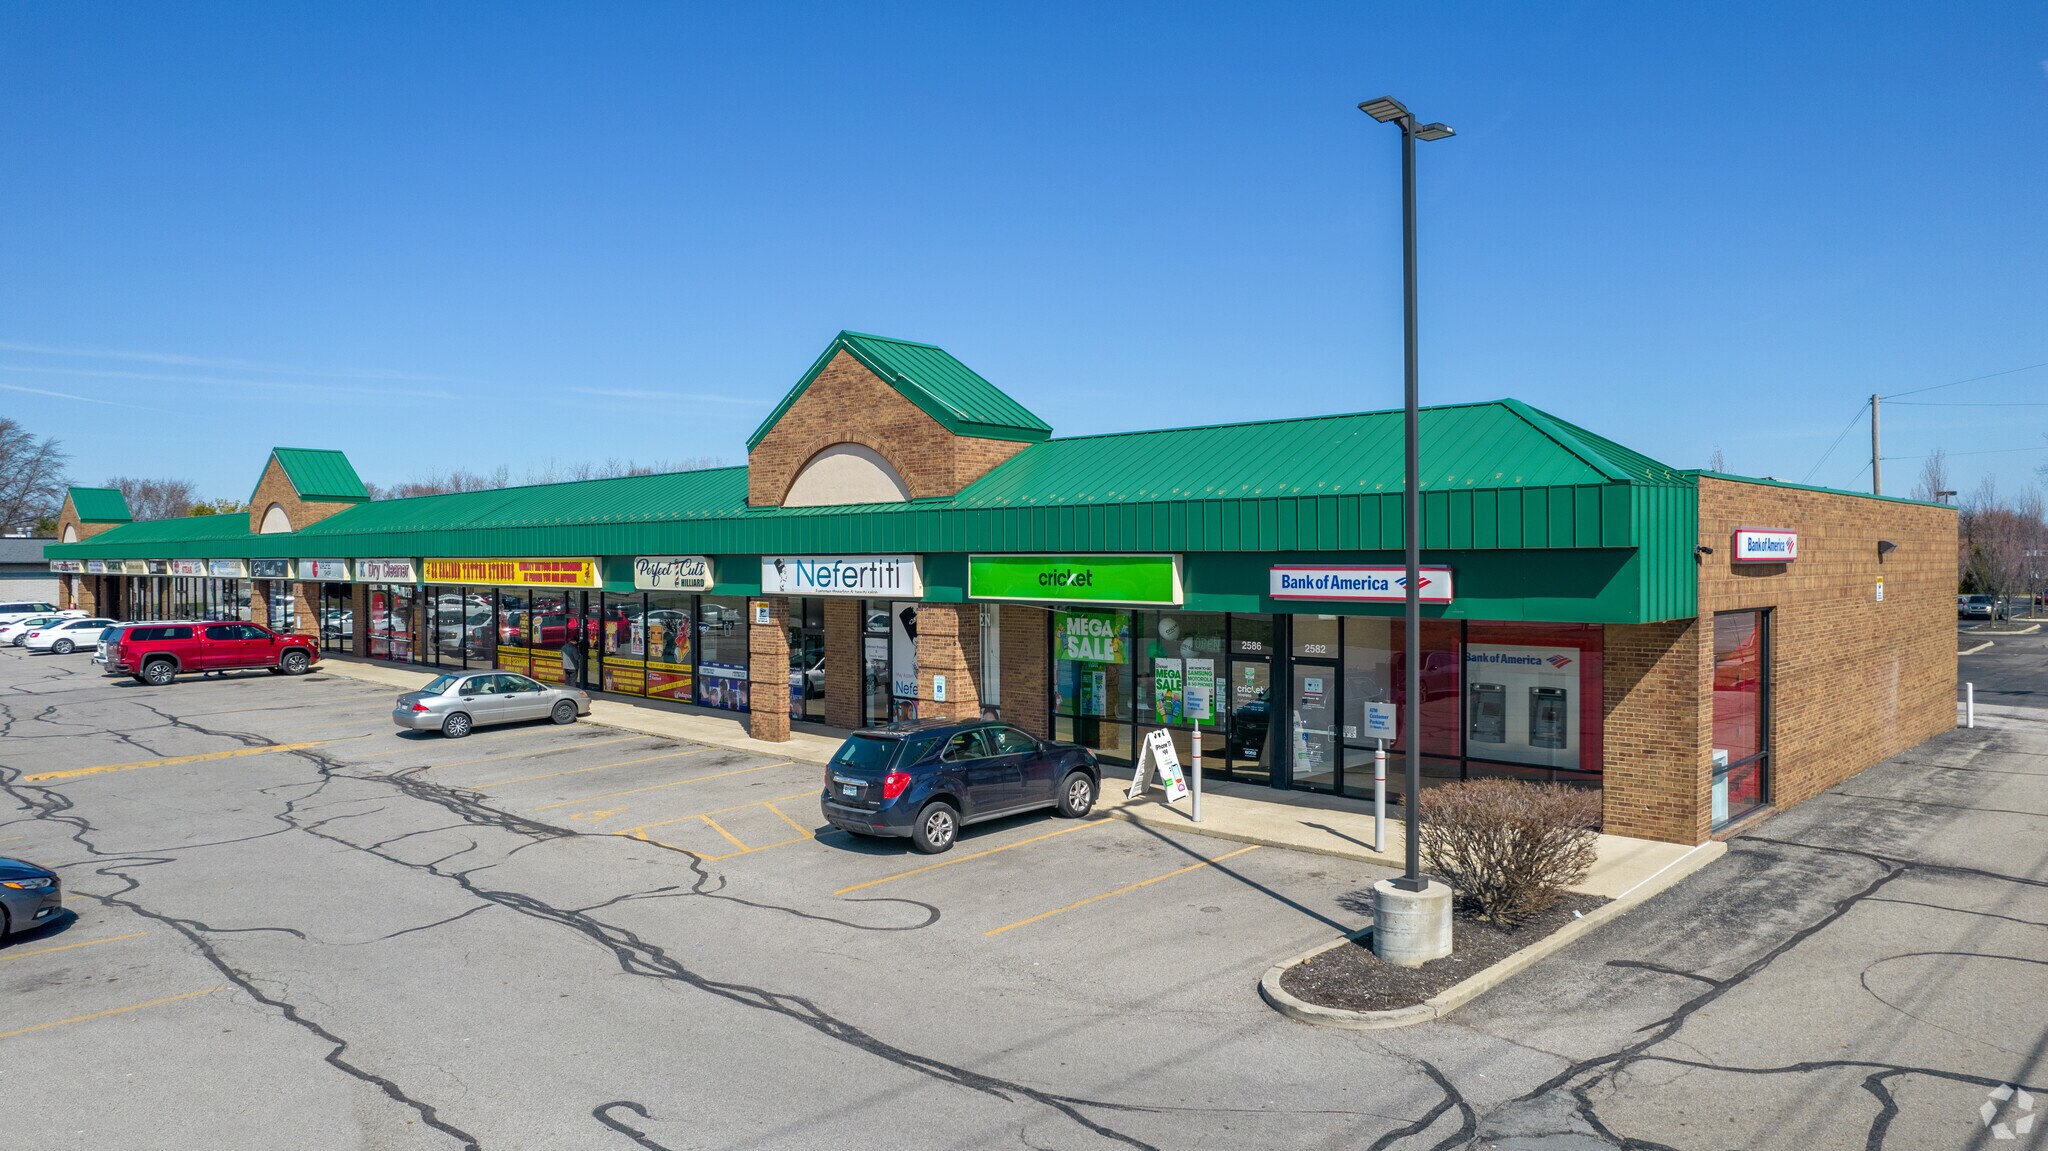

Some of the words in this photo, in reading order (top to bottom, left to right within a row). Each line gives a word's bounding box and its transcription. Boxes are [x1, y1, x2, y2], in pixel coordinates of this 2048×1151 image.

[1748, 537, 1761, 551] Bank
[1767, 538, 1784, 551] America
[360, 561, 365, 577] K
[368, 561, 380, 580] Dry
[383, 561, 409, 578] Cleaner
[636, 558, 676, 587] Perfect
[679, 558, 705, 577] Cuts
[796, 559, 900, 588] Nefertiti
[681, 578, 704, 588] HILLIARD
[1038, 569, 1093, 587] cricket
[1281, 574, 1314, 589] Bank
[1315, 574, 1329, 590] of
[1331, 575, 1389, 591] America
[1066, 617, 1114, 638] MEGA
[1068, 636, 1115, 661] SALE
[1241, 641, 1262, 651] 2586
[1304, 644, 1326, 654] 2582
[1466, 652, 1489, 662] Bank
[1490, 653, 1501, 663] of
[1501, 653, 1542, 665] America
[1156, 669, 1181, 679] MEGA
[1156, 679, 1182, 691] SALE
[1237, 685, 1264, 695] cricket
